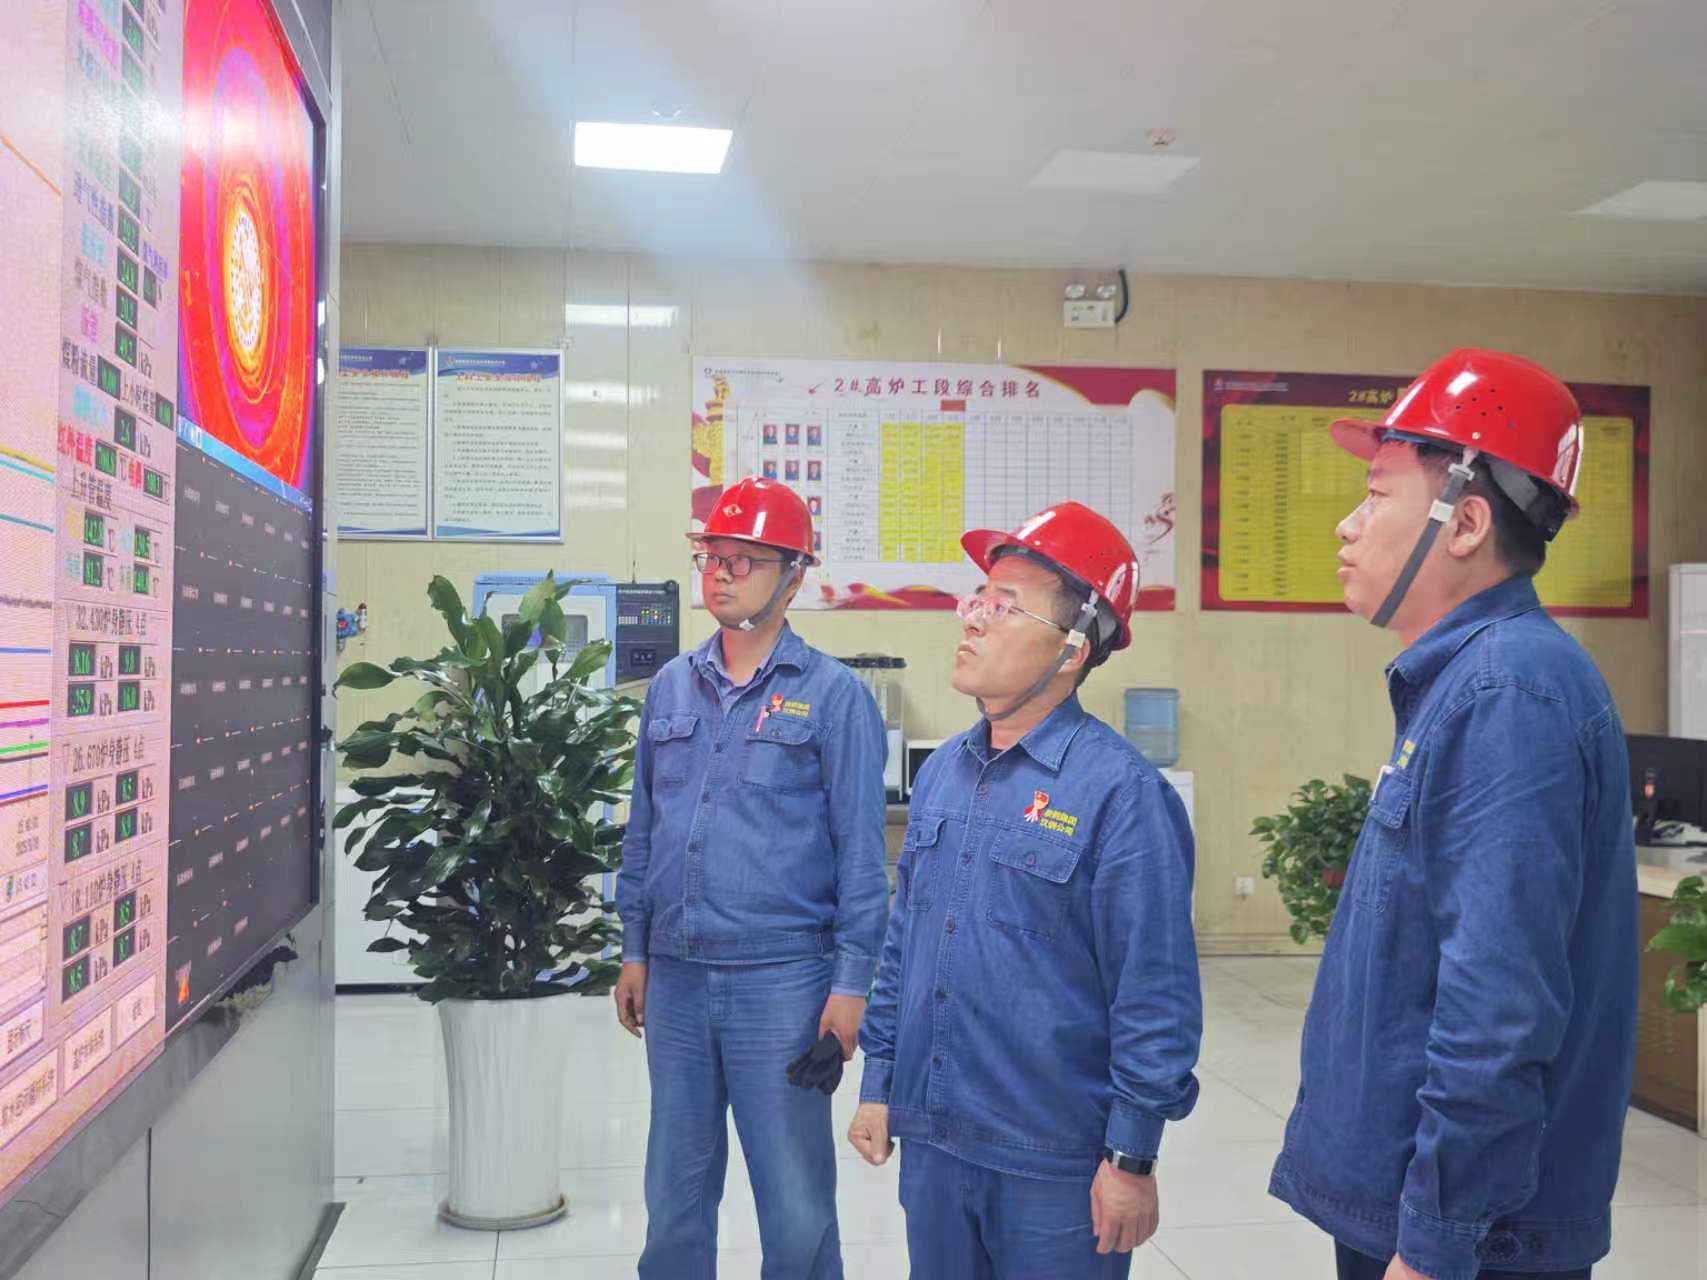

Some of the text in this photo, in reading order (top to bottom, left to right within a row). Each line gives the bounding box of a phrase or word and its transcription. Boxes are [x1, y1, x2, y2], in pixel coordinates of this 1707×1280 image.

[835, 378, 1040, 398] 2#高炉工段综合排名
